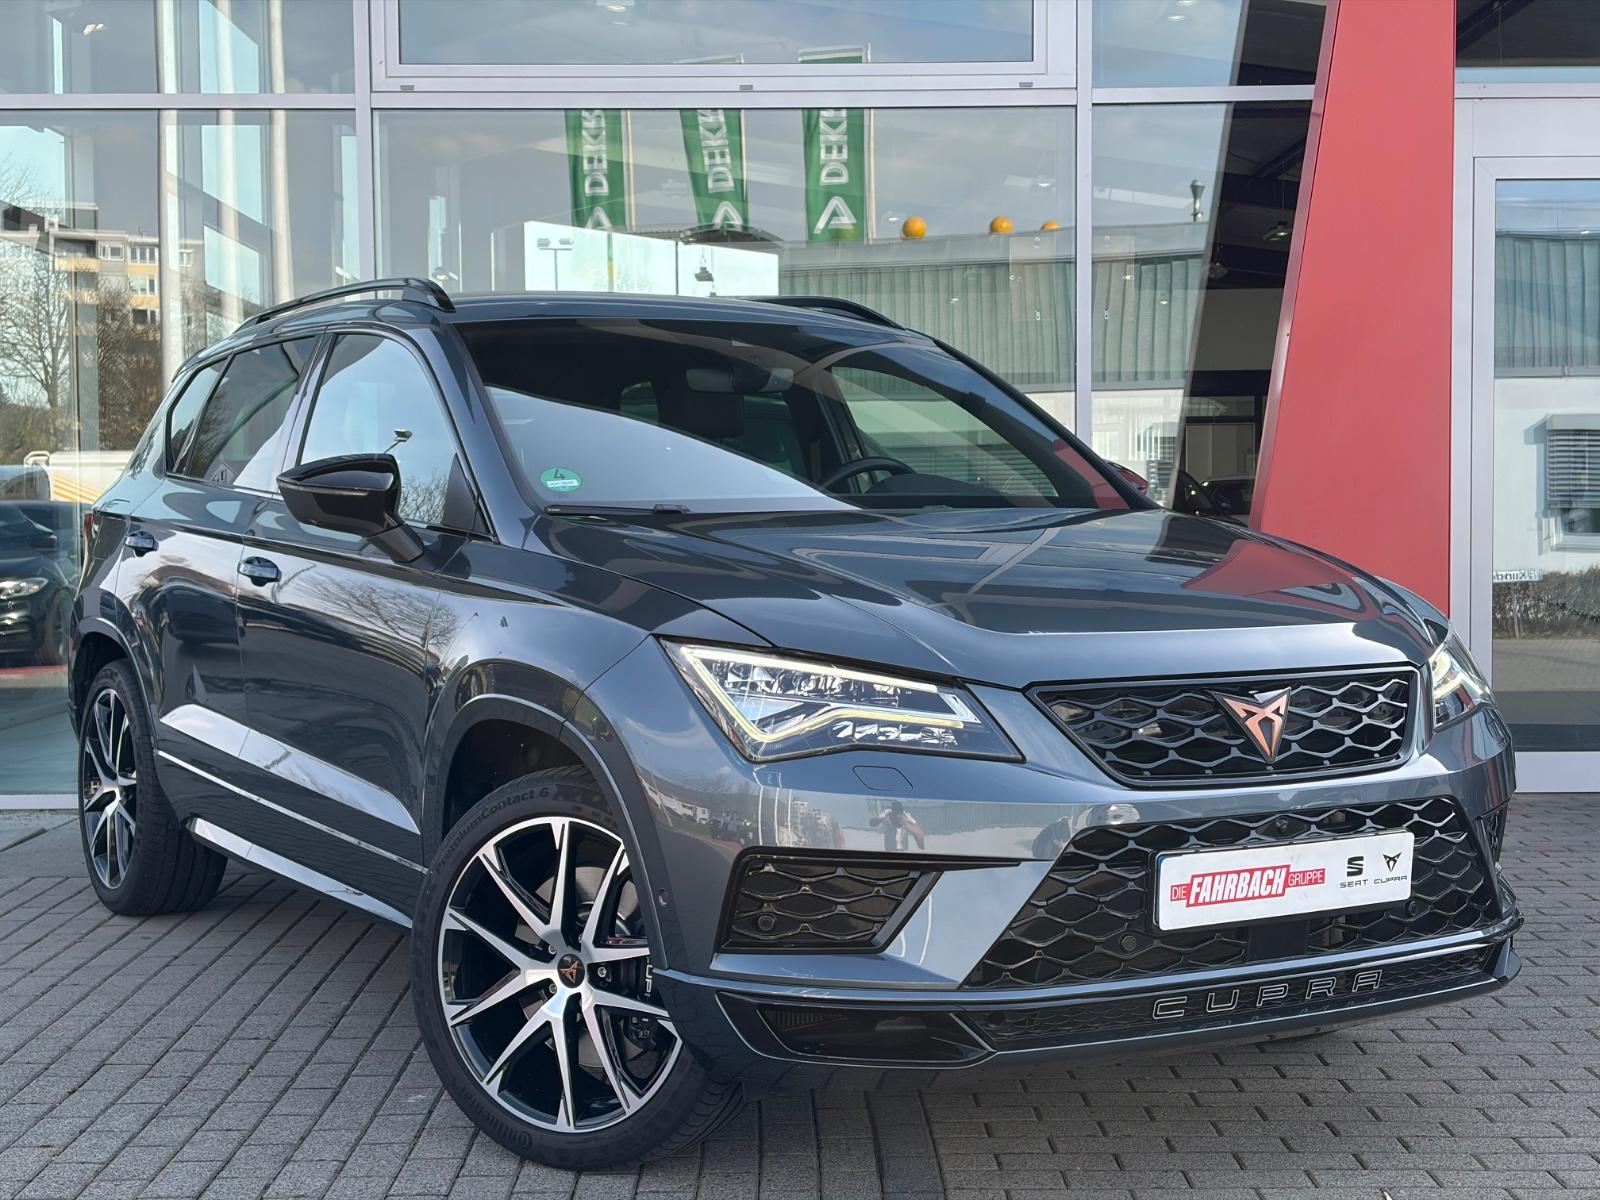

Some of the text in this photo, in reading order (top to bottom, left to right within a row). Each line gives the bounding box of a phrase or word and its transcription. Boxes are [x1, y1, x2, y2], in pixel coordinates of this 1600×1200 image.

[539, 786, 551, 799] 6
[1171, 868, 1324, 905] DIE FAHRBACH GRUPPE
[1340, 875, 1407, 889] SEAT CUPRA
[1152, 969, 1384, 1020] CUPRA
